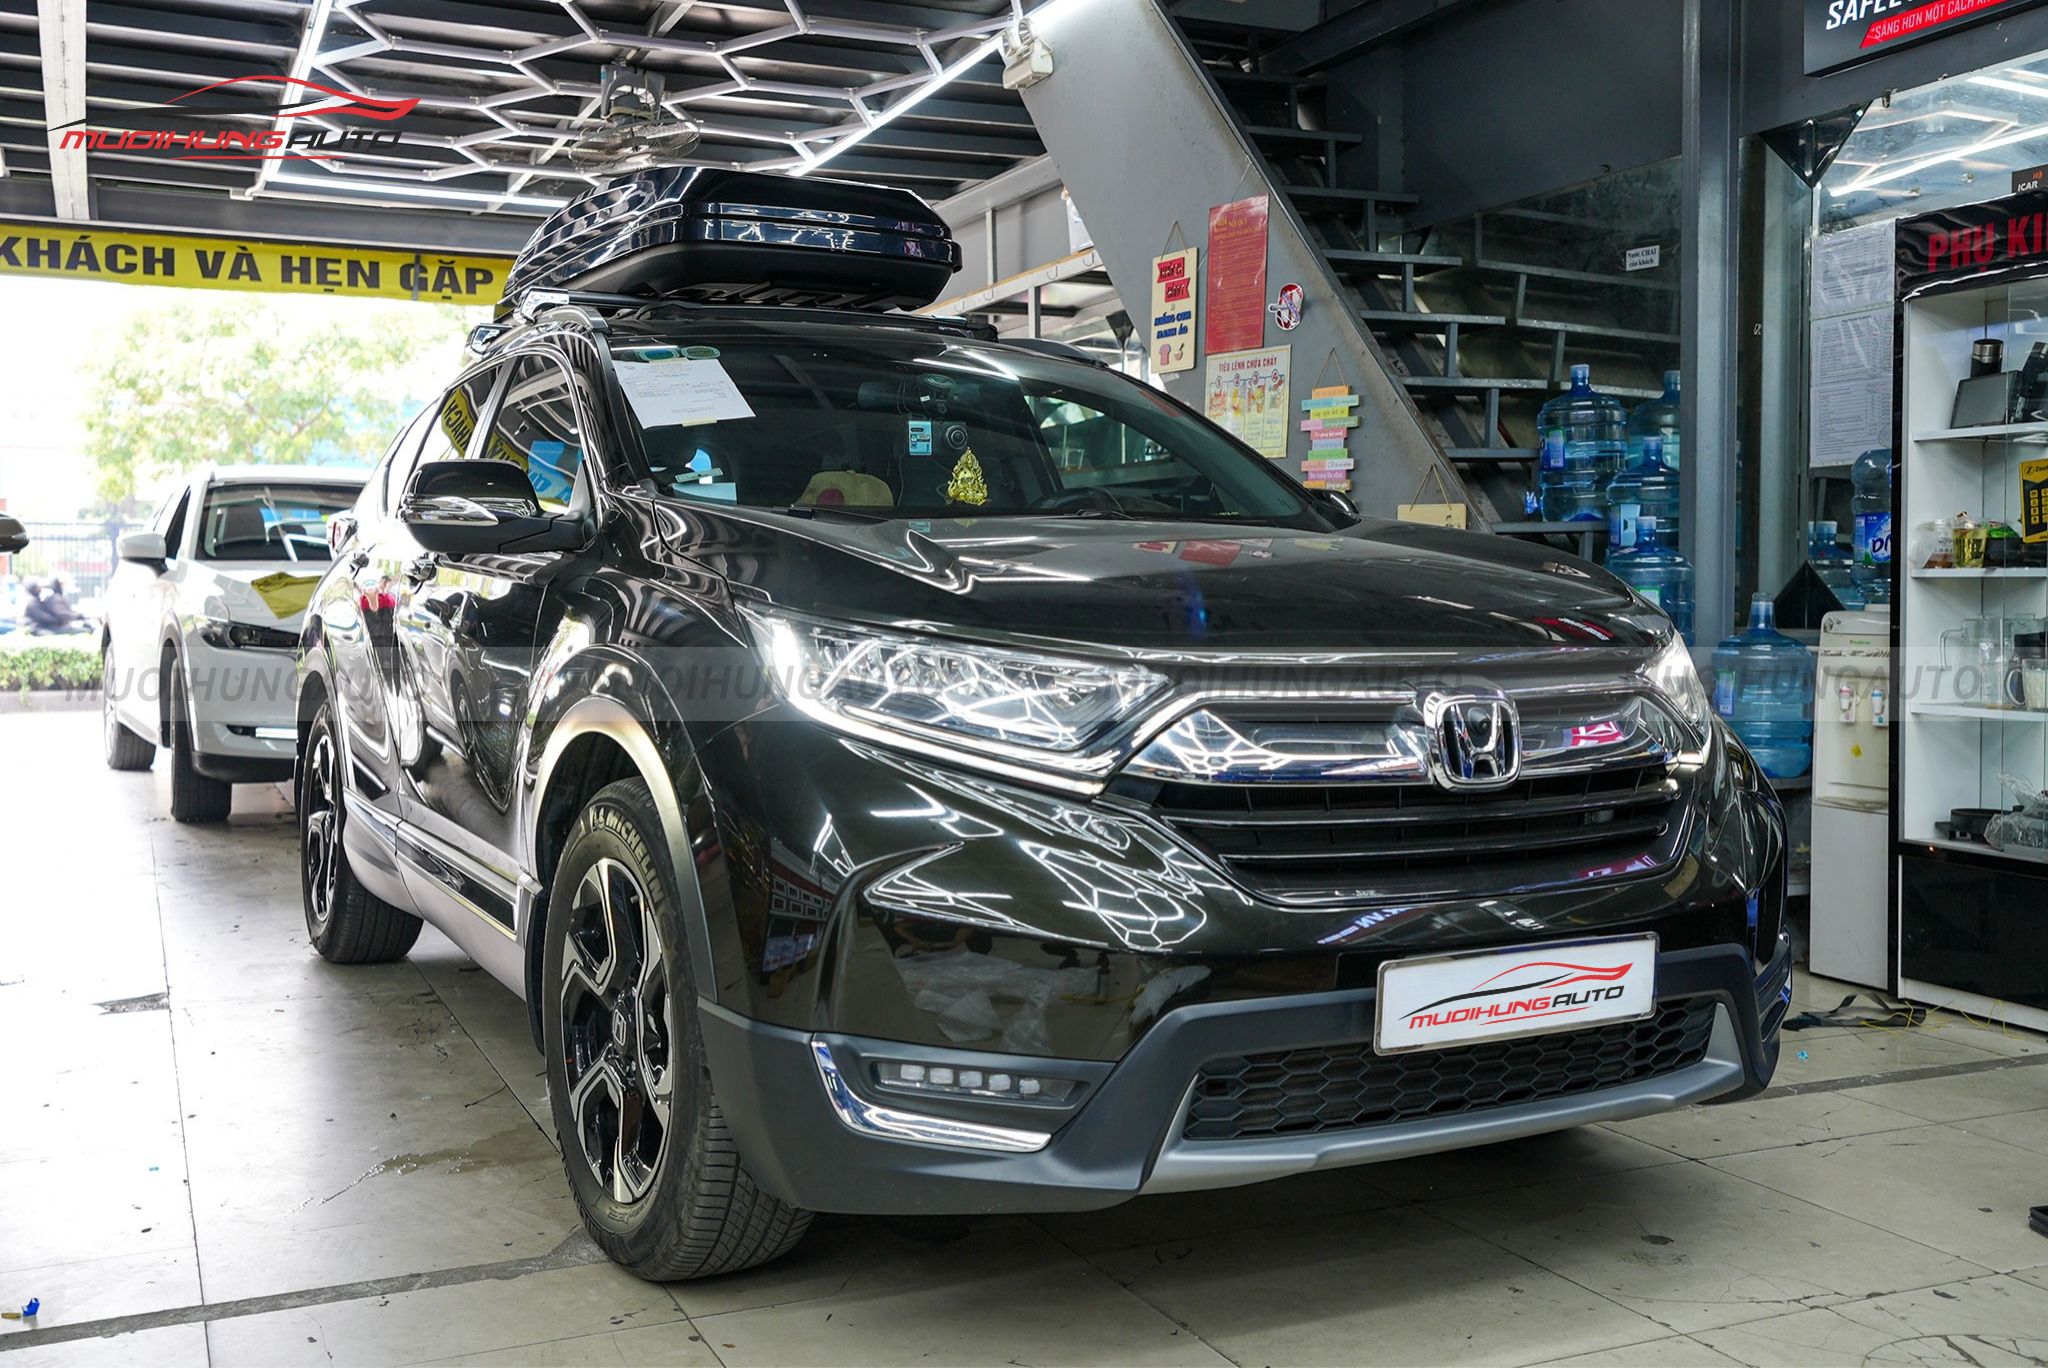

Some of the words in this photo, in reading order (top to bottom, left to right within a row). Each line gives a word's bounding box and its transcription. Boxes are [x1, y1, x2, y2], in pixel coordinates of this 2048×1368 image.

[1925, 3, 1945, 24] MỘT
[1928, 222, 1995, 272] PHỤ
[2007, 212, 2048, 259] KI
[195, 245, 262, 282] VÀ
[280, 255, 380, 293] HẸN
[399, 259, 494, 300] GẶP
[606, 809, 664, 904] MICHELIN
